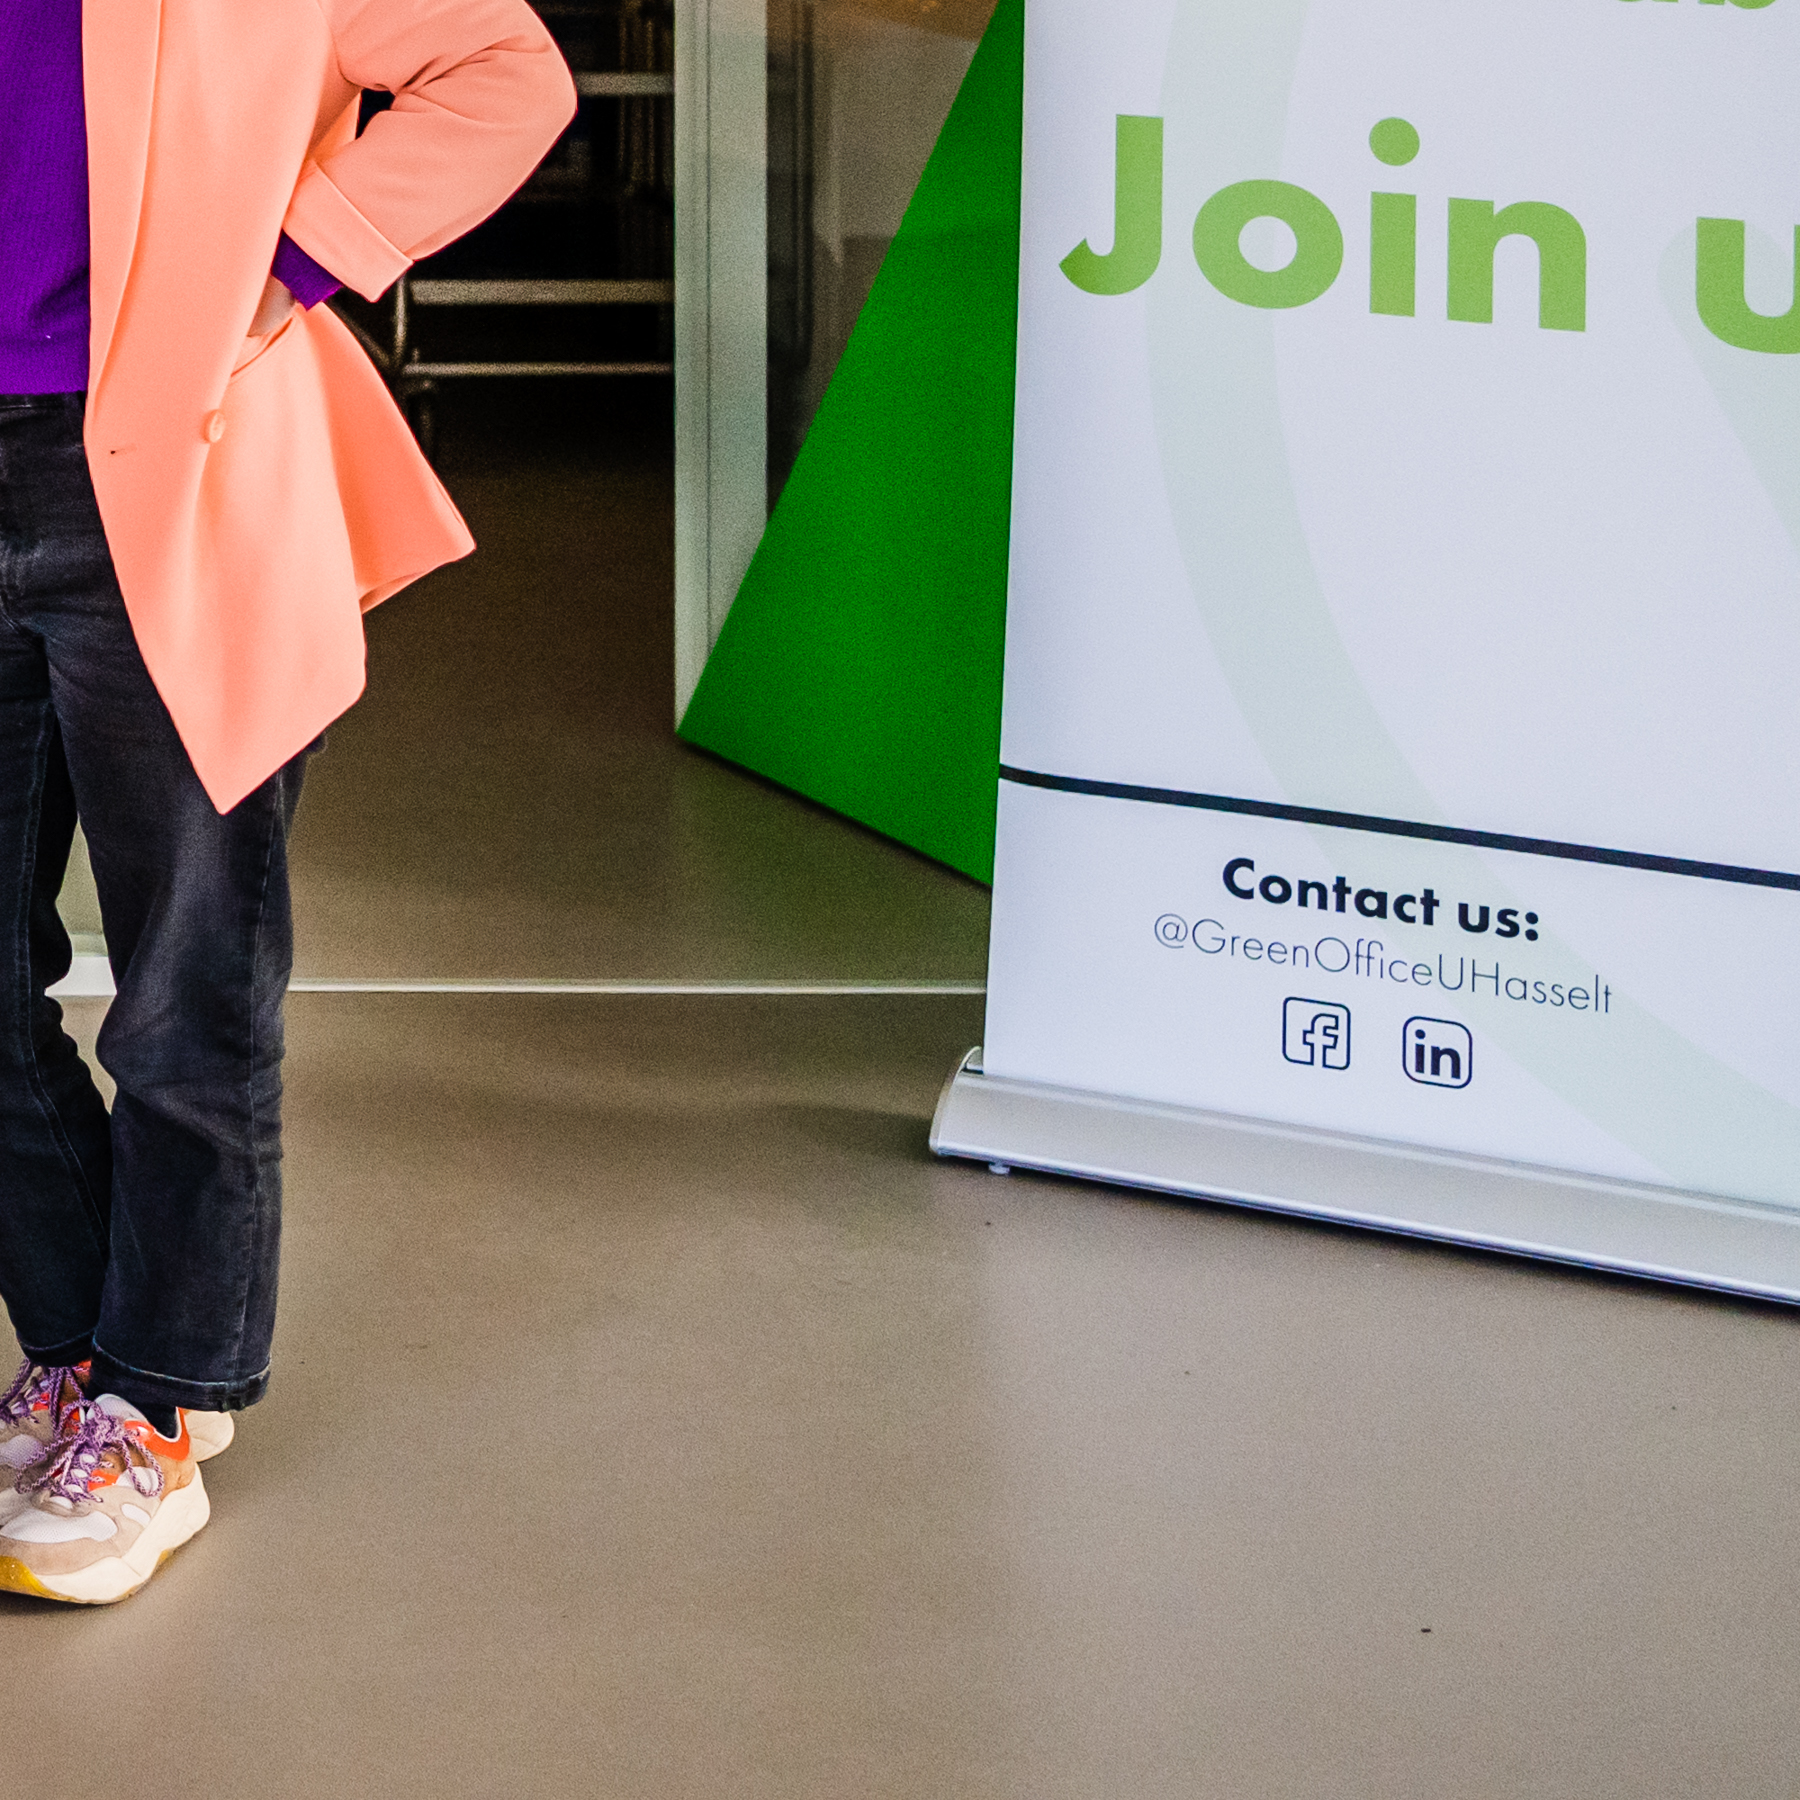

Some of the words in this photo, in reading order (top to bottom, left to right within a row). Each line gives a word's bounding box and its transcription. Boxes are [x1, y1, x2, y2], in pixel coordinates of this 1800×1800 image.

[1059, 113, 1587, 332] Join
[1222, 856, 1440, 927] Contact
[1458, 901, 1540, 943] us:
[1153, 913, 1614, 1014] @GreenOfficeUHasselt
